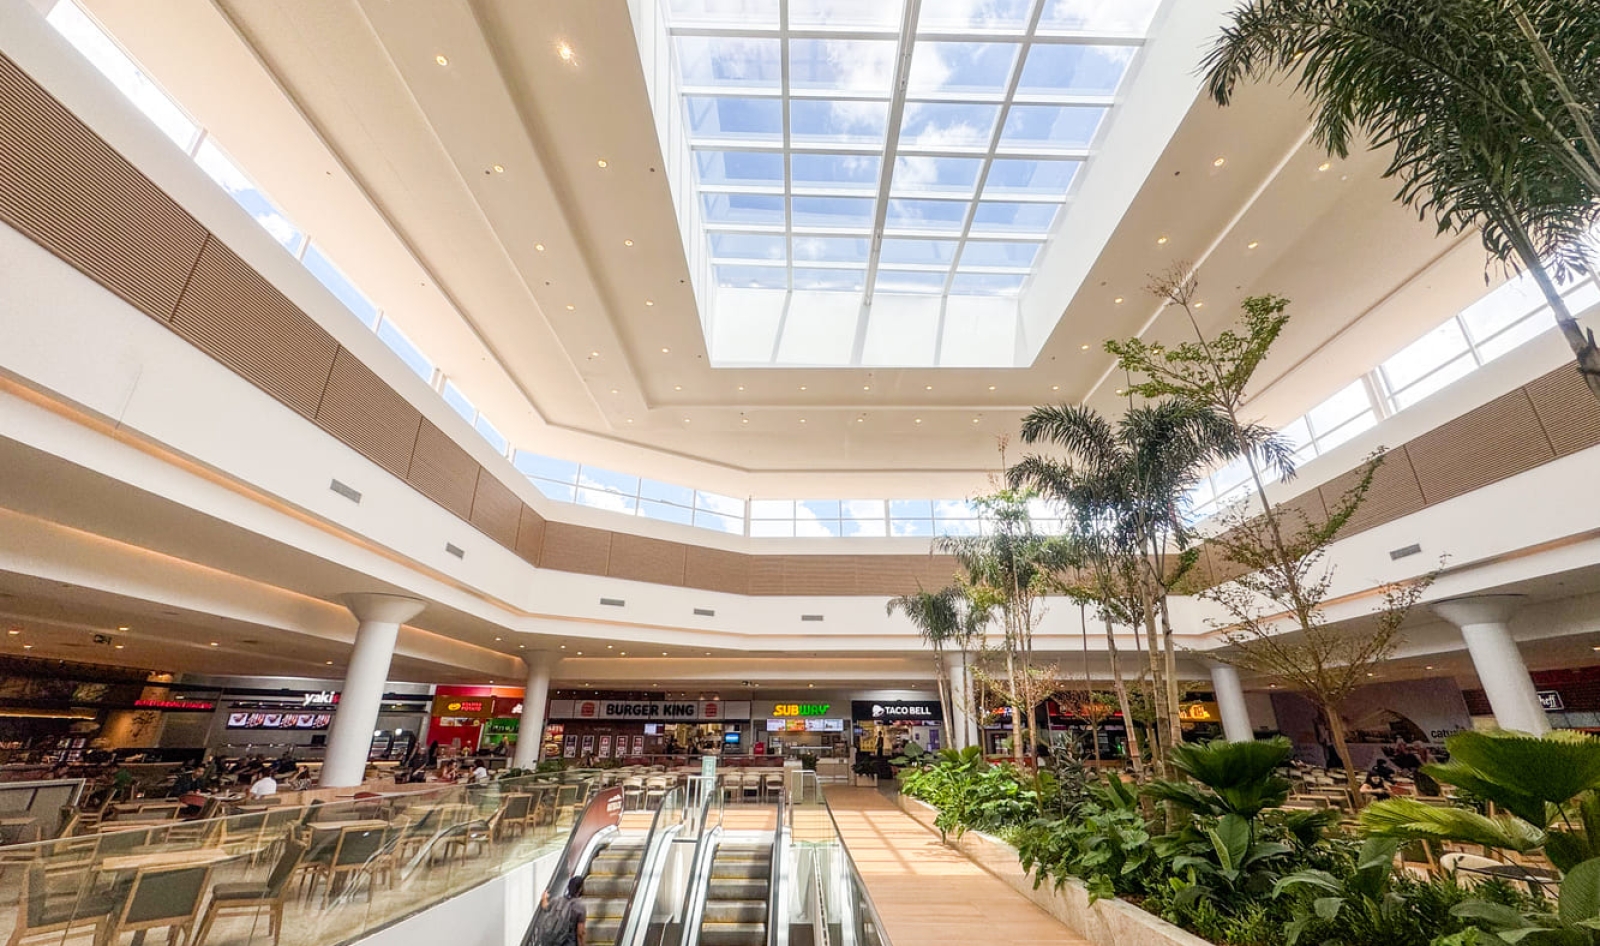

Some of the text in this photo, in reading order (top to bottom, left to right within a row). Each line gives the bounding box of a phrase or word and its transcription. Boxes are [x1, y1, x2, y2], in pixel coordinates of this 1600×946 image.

[606, 703, 659, 716] BURGER
[663, 703, 695, 716] KING
[773, 703, 830, 717] SUBWAY
[884, 705, 932, 715] TACO BELL
